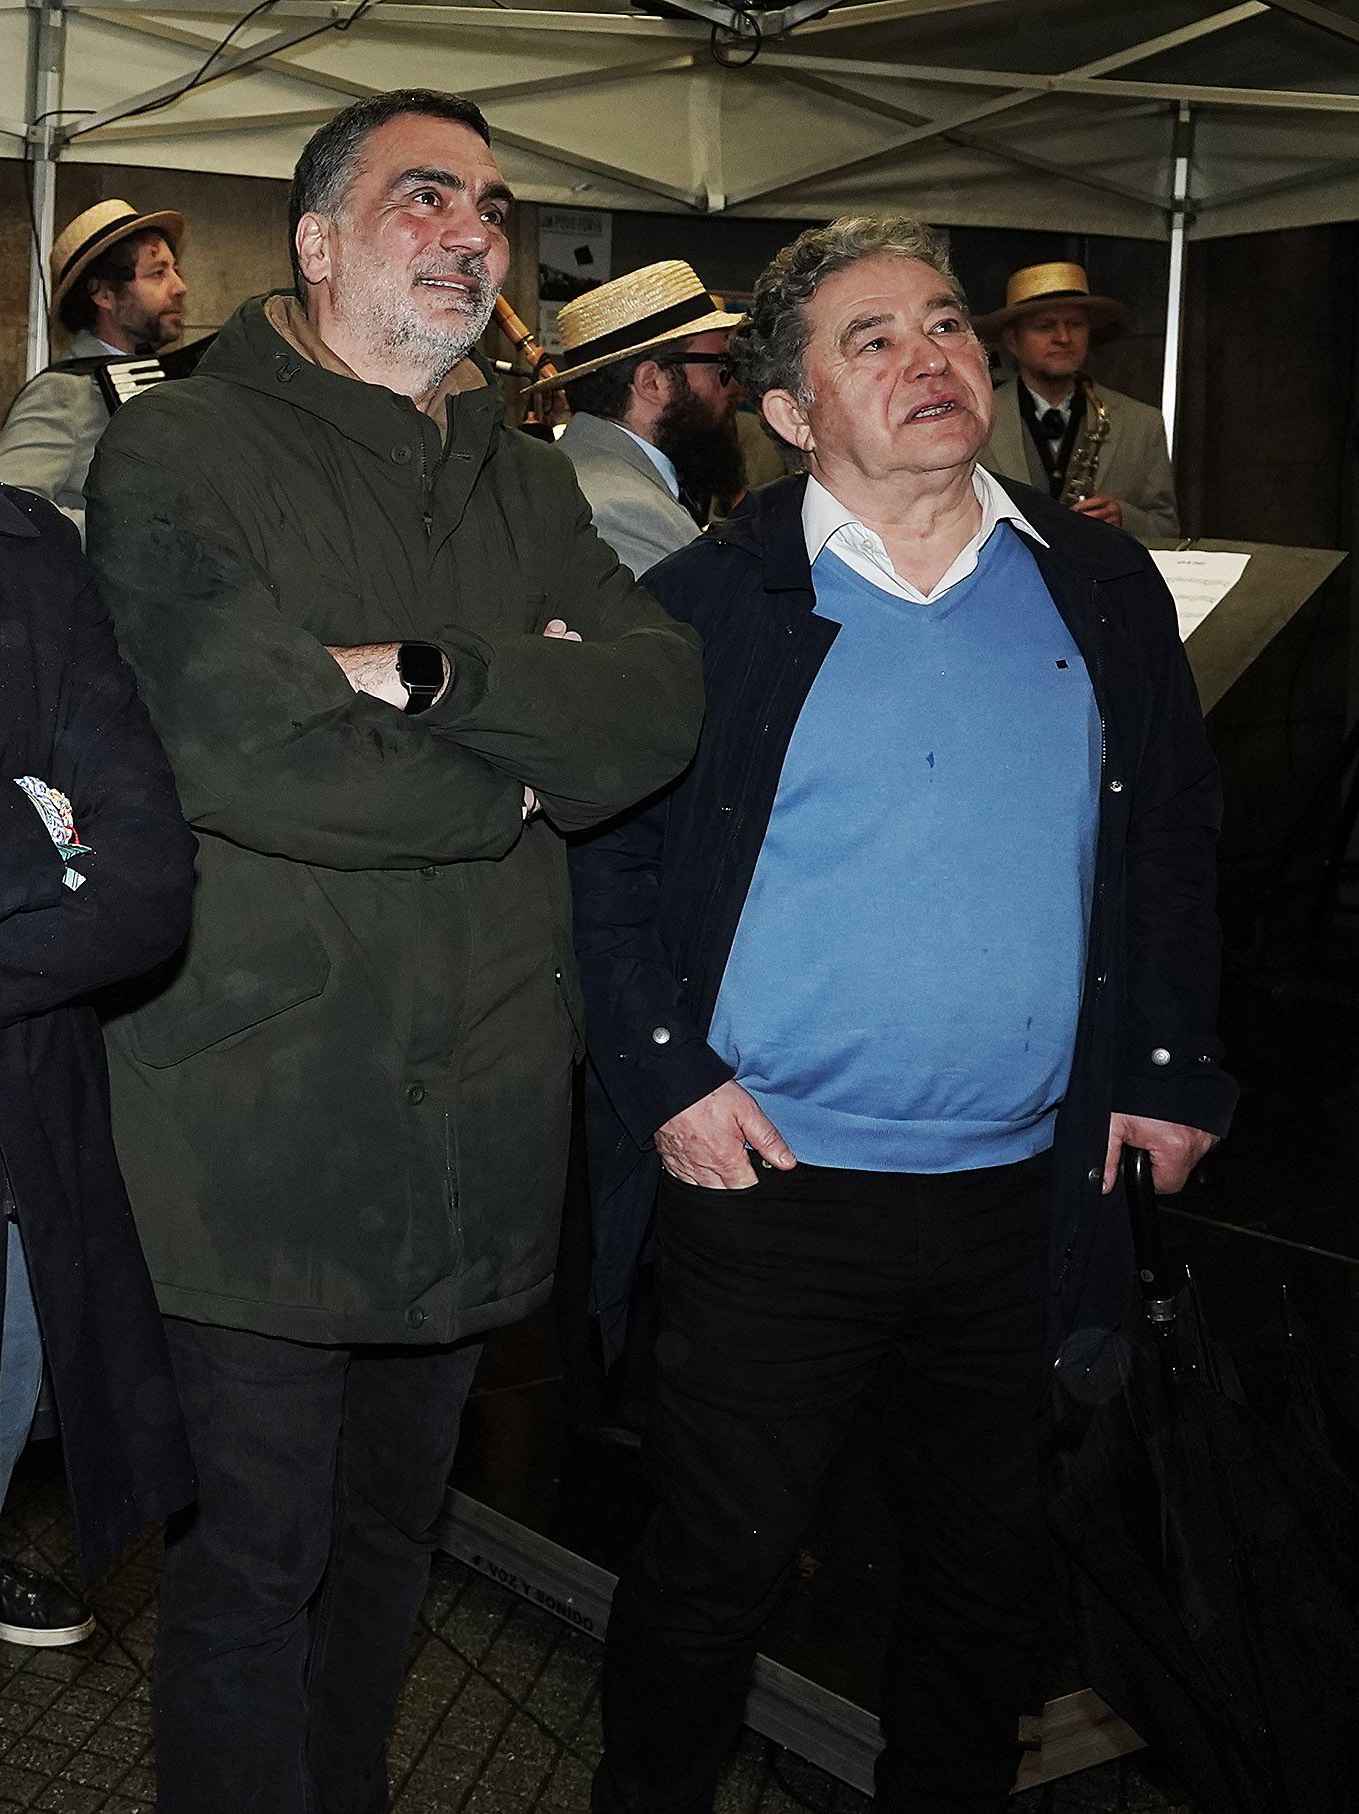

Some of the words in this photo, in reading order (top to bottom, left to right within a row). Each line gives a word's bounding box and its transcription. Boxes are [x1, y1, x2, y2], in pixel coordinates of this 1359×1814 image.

[487, 1560, 517, 1588] VOZ
[520, 1581, 532, 1596] Y
[536, 1589, 594, 1632] SONIDO
